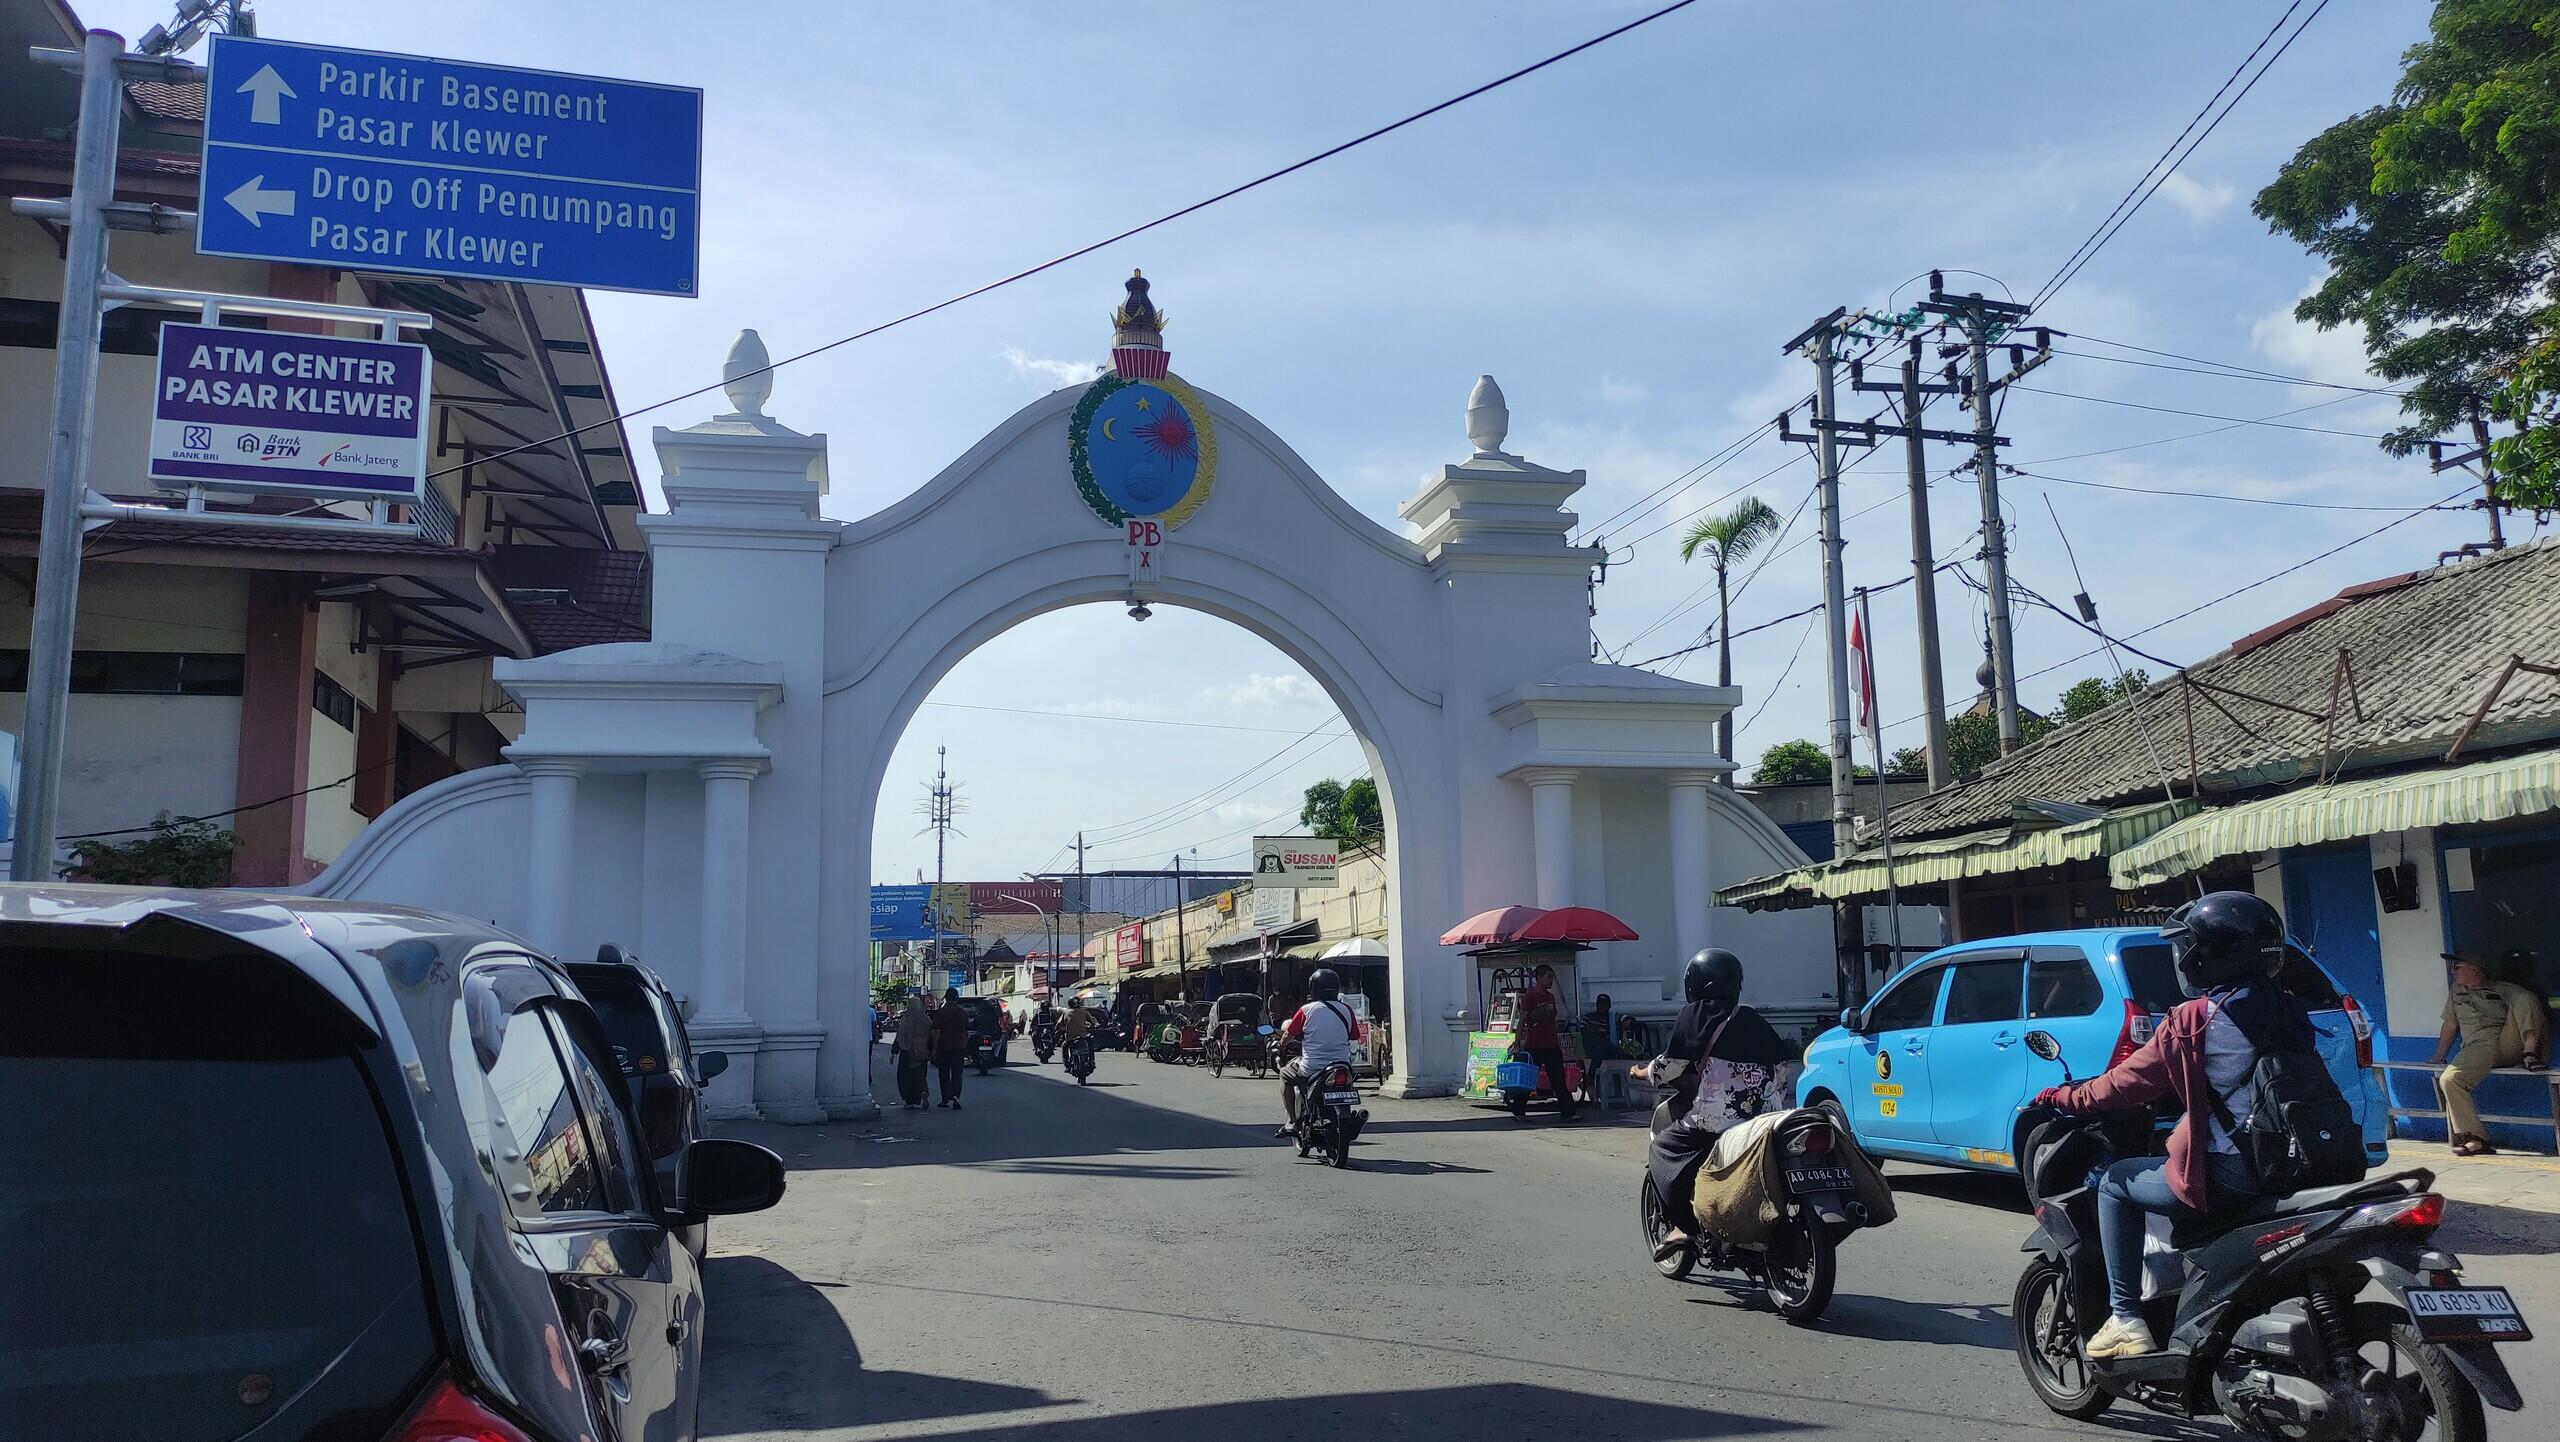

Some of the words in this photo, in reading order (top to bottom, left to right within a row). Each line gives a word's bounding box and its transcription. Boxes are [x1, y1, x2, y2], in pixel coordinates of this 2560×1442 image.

[318, 62, 425, 103] Parkir
[441, 75, 608, 124] Basement
[316, 107, 414, 148] Pasar
[430, 120, 548, 160] Klewer
[311, 167, 394, 213] Drop
[410, 177, 462, 212] Off
[478, 183, 676, 241] Penumpang
[309, 216, 408, 256] Pasar
[424, 227, 544, 268] Klewer
[188, 344, 264, 374] ATM
[271, 351, 396, 385] CENTER
[165, 376, 278, 409] PASAR
[285, 386, 414, 420] KLEWER
[268, 434, 301, 447] Bank
[172, 451, 200, 460] BANK
[202, 452, 219, 461] BRI
[262, 445, 302, 457] BTN
[334, 452, 362, 464] Bank
[362, 454, 399, 468] Jateng
[1128, 521, 1161, 546] PB
[1141, 551, 1150, 567] X
[1284, 854, 1336, 864] SUSSAN
[876, 903, 898, 914] siap
[1888, 1085, 1902, 1095] SOLO
[1882, 1102, 1895, 1115] 024
[1790, 1171, 1805, 1182] AD
[1807, 1169, 1832, 1180] 4084
[2415, 1293, 2438, 1312] AD
[2439, 1293, 2481, 1311] 6839
